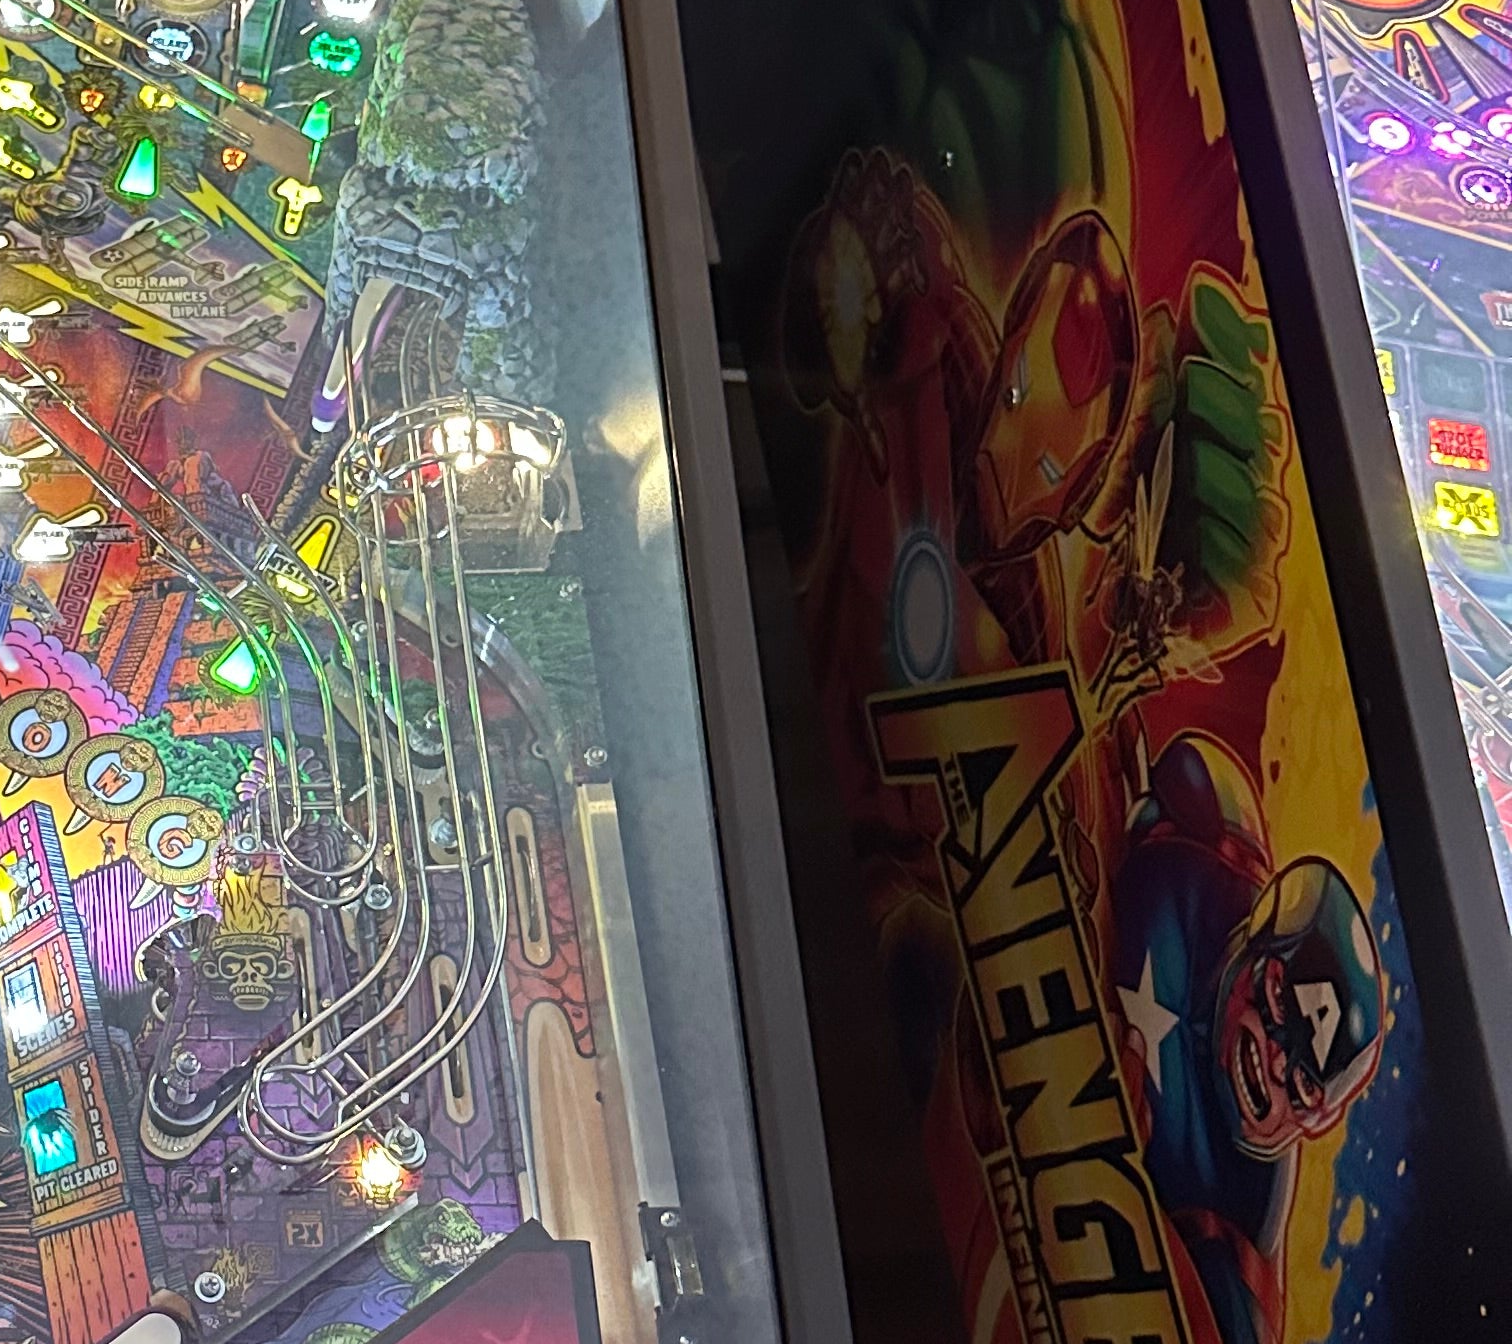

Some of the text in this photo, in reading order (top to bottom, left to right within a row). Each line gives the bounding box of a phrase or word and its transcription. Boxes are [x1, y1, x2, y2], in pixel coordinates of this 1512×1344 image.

[115, 276, 188, 288] SIDE RAMP
[139, 292, 207, 304] ADVANCES
[171, 306, 228, 318] BIPLANE
[22, 722, 51, 753] O
[92, 764, 131, 798] N
[18, 818, 44, 896] CLIMB
[53, 940, 72, 1008] ISLAND
[16, 1010, 76, 1058] SCENES
[79, 1060, 107, 1156] SPIDER
[35, 1159, 118, 1202] PIT CLEARED
[292, 1223, 323, 1246] 2X
